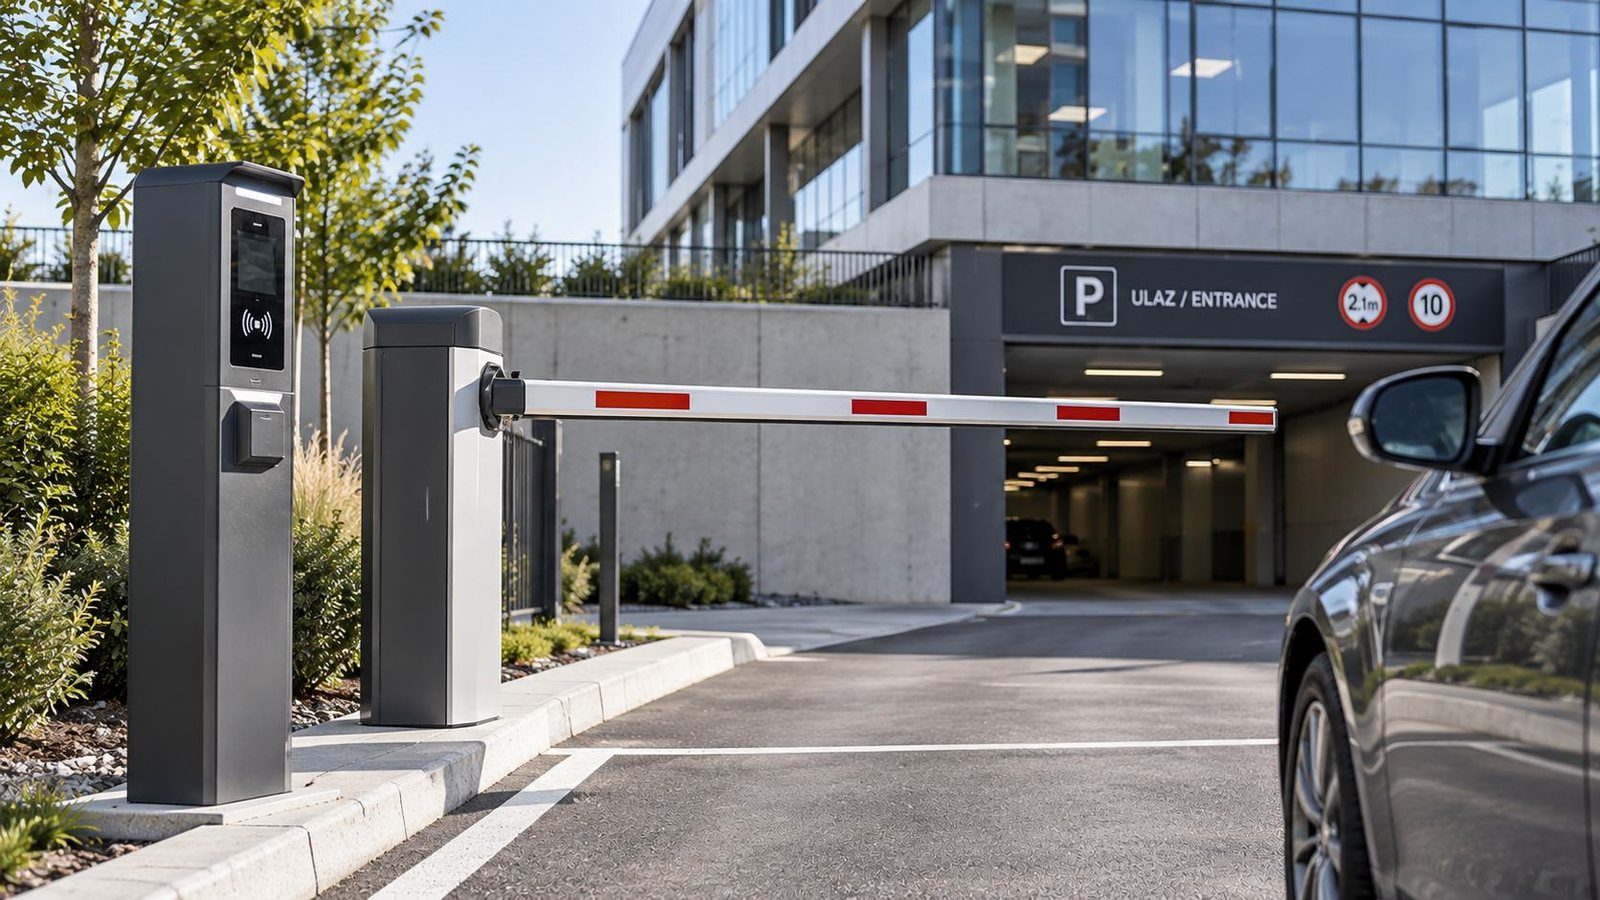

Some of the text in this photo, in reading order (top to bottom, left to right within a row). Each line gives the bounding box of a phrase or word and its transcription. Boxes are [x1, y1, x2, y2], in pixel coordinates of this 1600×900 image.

[1075, 275, 1105, 316] P
[1131, 289, 1278, 310] ULAZ / ENTRANCE
[1348, 293, 1379, 311] 2.1m
[1420, 294, 1443, 316] 10
